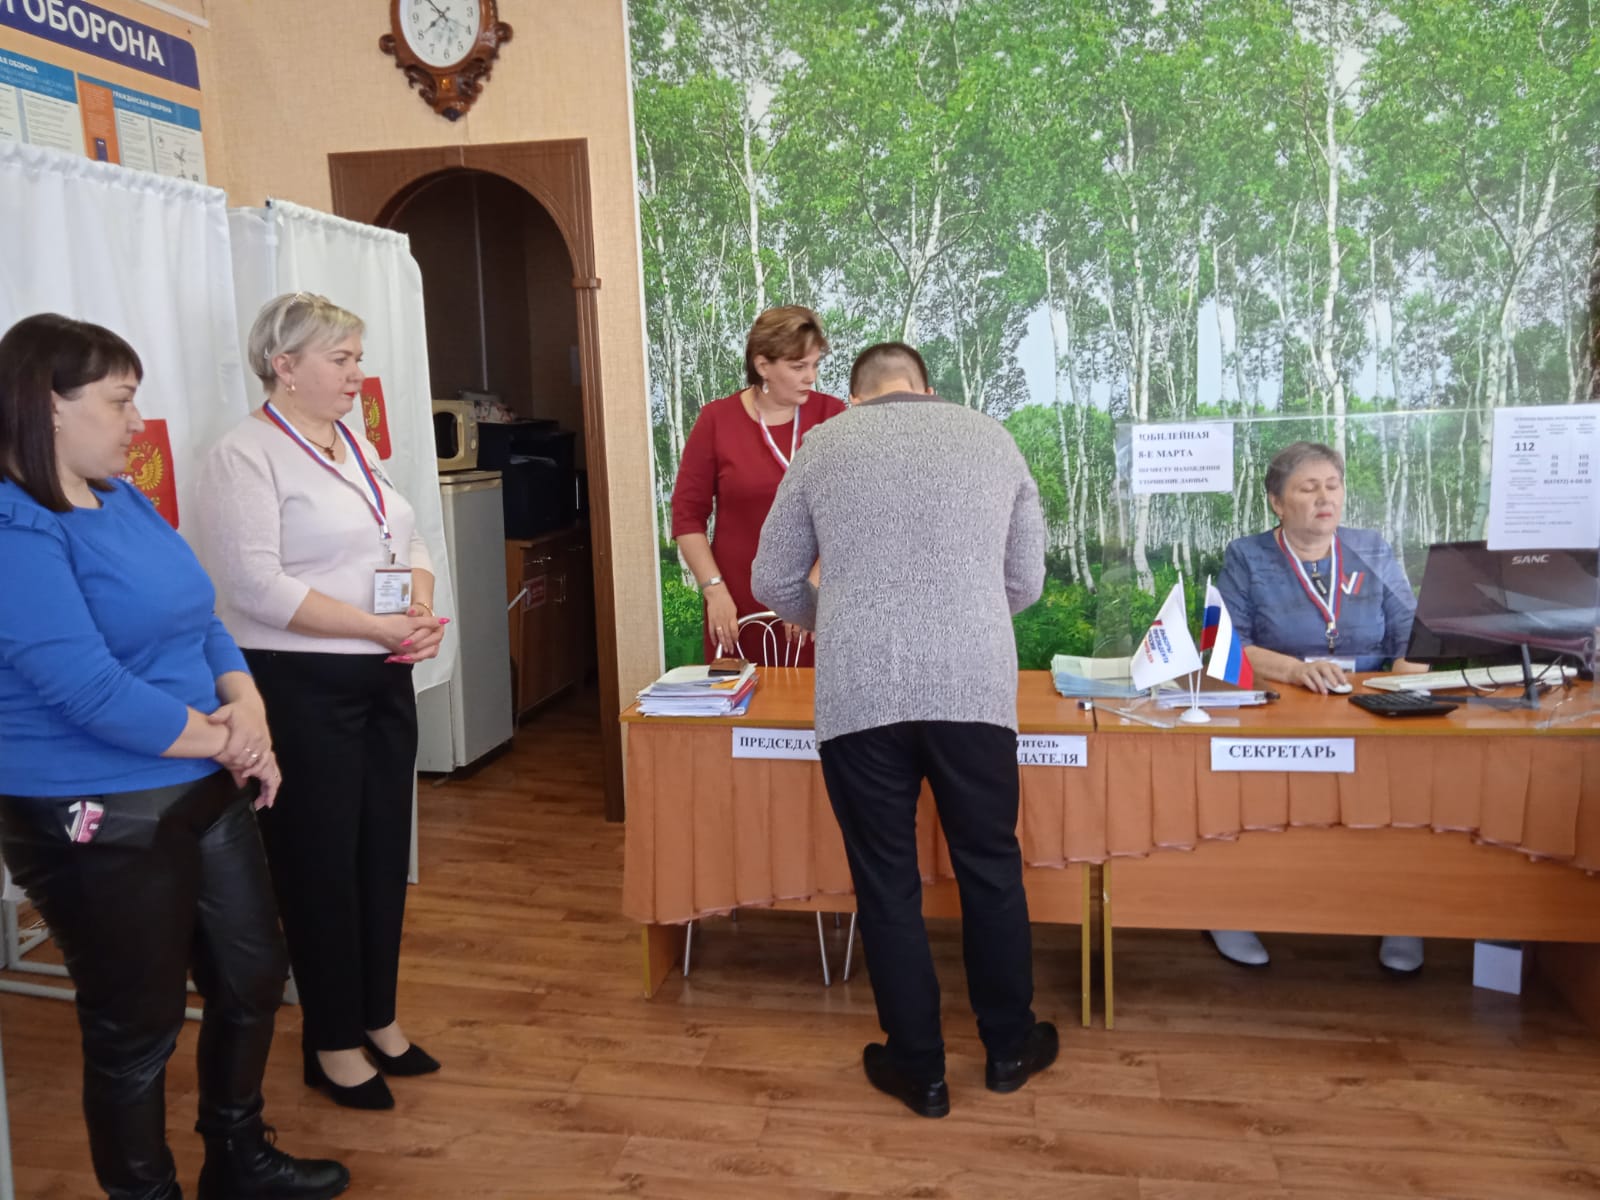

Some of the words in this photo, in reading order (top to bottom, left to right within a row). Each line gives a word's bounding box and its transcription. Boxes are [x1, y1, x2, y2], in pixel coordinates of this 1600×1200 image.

[466, 6, 473, 17] 3
[412, 12, 419, 23] 9
[23, 0, 165, 67] ОБОРОНА
[417, 29, 425, 40] 8
[466, 24, 472, 35] 4
[429, 43, 435, 54] 7
[443, 48, 450, 59] 6
[1139, 430, 1209, 441] ЮБИЛЕЙНАЯ
[1515, 442, 1535, 451] 112
[1156, 448, 1193, 458] МАРТА
[1512, 554, 1550, 565] SANC
[1228, 745, 1336, 758] СЕКРЕТАРЬ
